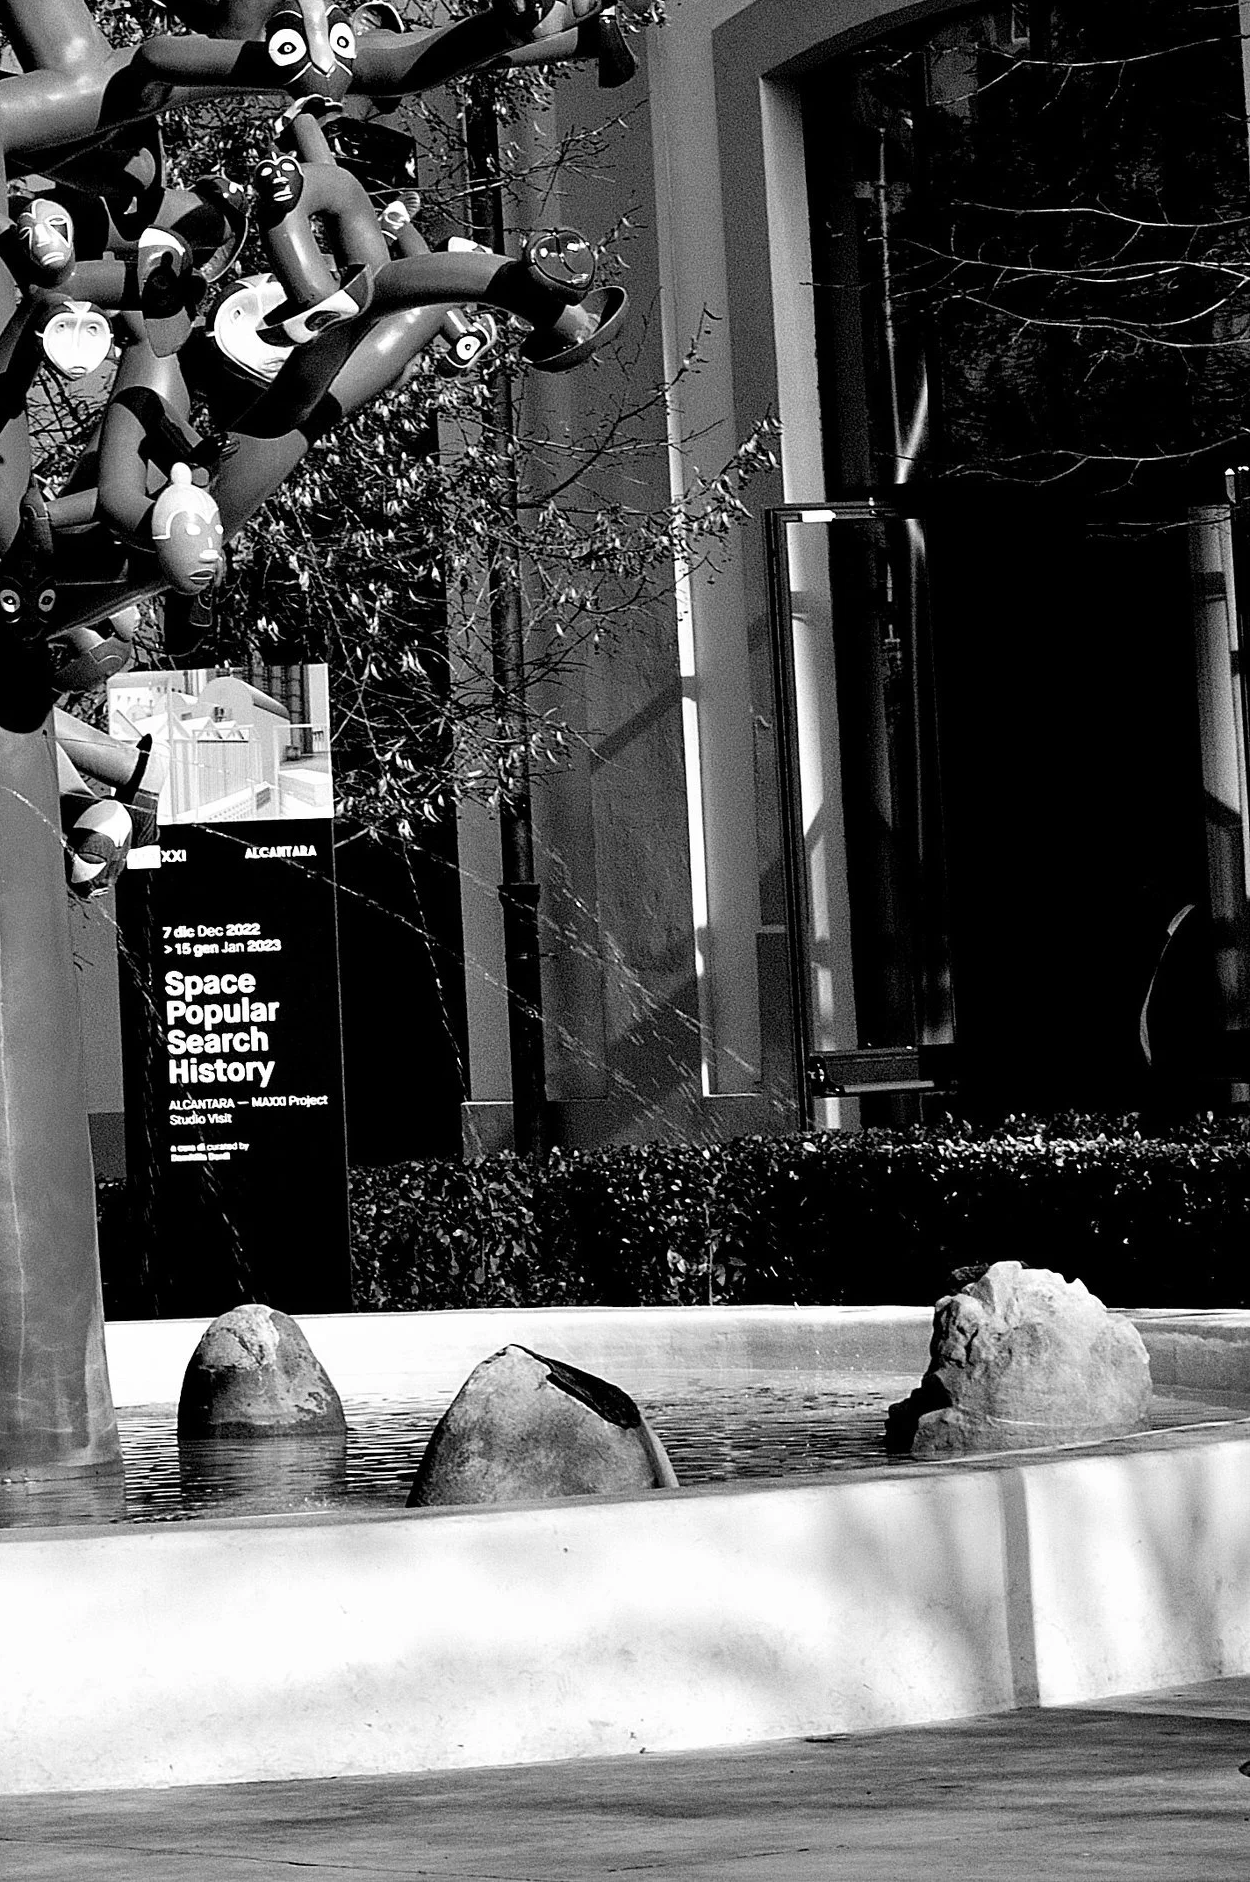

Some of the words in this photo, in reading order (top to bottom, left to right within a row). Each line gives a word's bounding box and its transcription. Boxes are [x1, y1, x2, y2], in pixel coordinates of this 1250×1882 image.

[245, 845, 317, 859] ALCANTARA
[162, 926, 172, 938] 7
[174, 925, 195, 938] dic
[197, 924, 224, 937] Dec
[226, 923, 261, 936] 2022
[175, 943, 191, 955] 15
[193, 943, 219, 957] gen
[221, 941, 245, 954] Jan
[247, 939, 281, 952] 2023
[164, 970, 256, 1002] Space
[166, 997, 280, 1031] Popular
[166, 1026, 269, 1055] Search
[168, 1058, 276, 1088] History
[169, 1098, 236, 1110] ALCANTARA
[288, 1095, 329, 1108] Project
[169, 1113, 206, 1125] Studio
[207, 1113, 232, 1124] Visit
